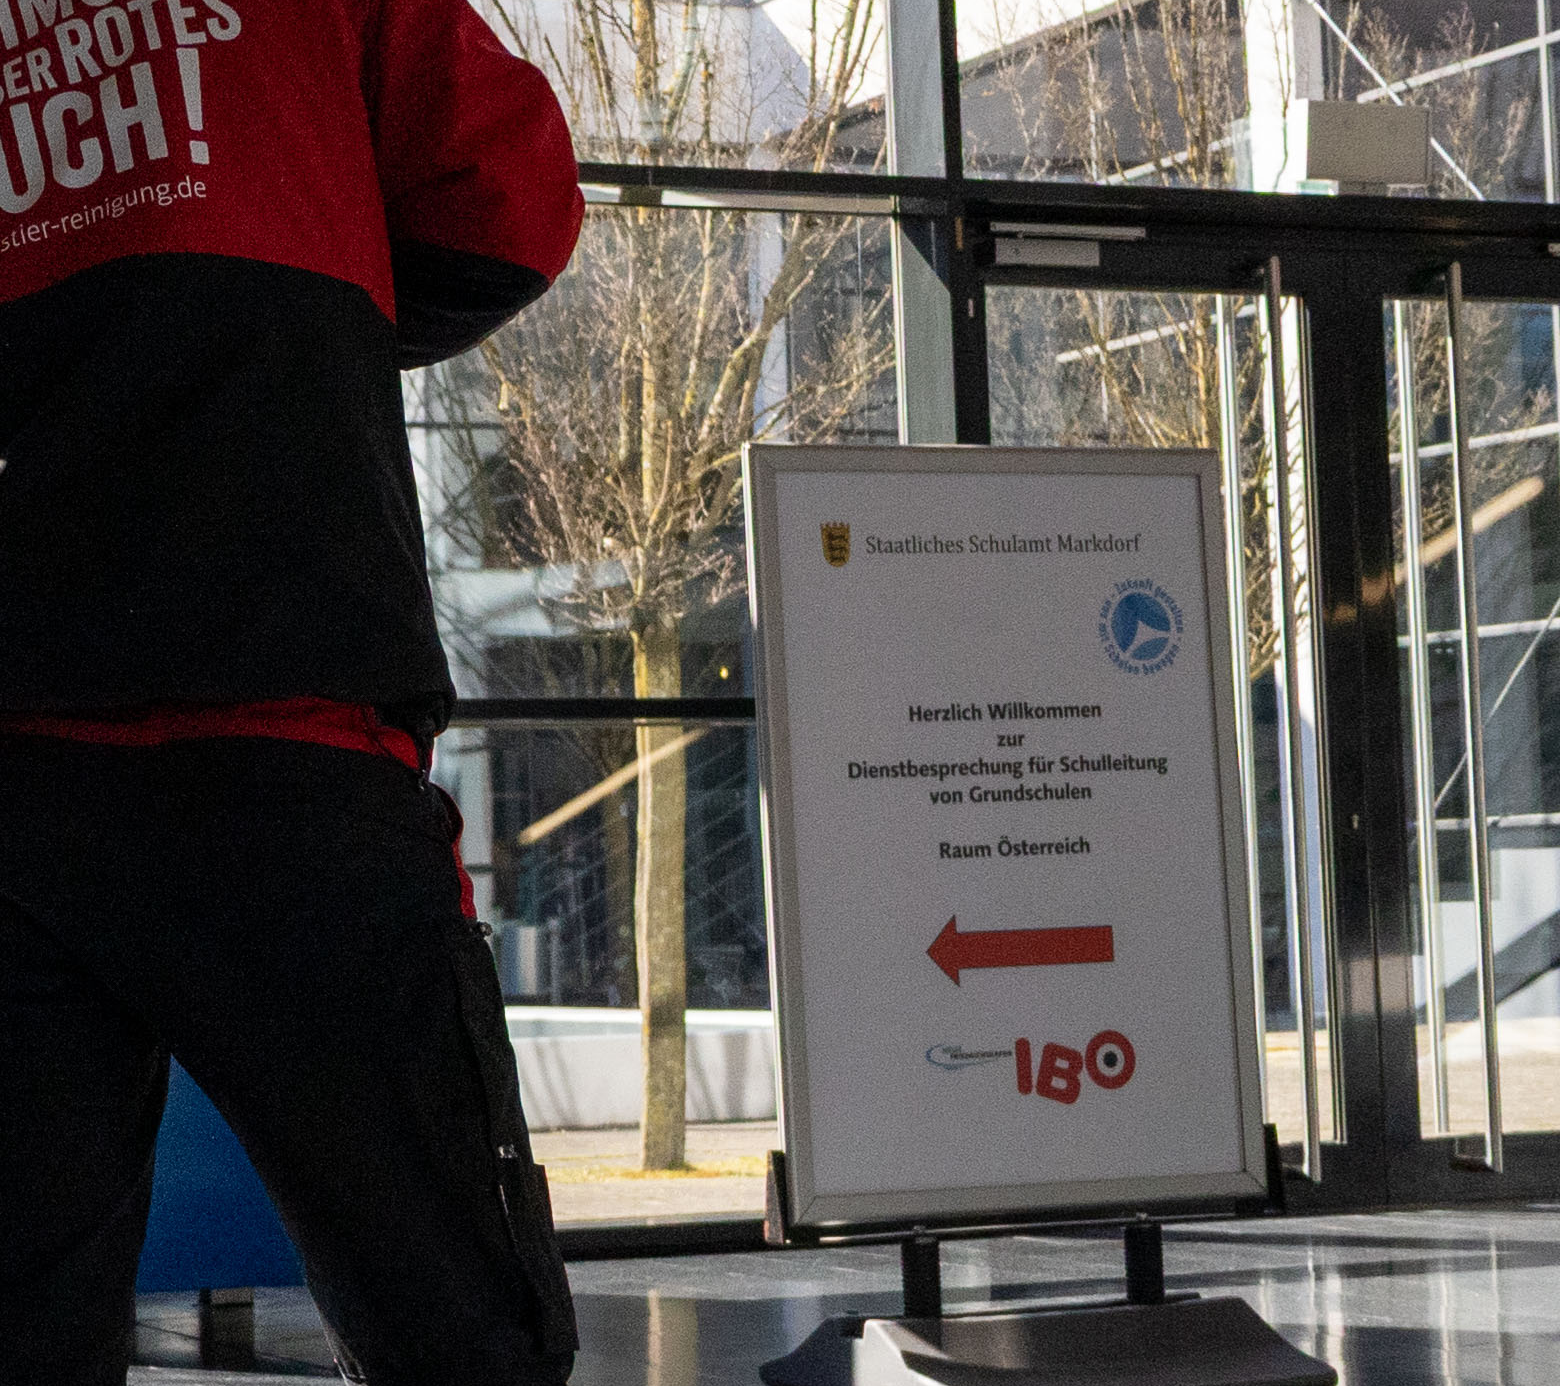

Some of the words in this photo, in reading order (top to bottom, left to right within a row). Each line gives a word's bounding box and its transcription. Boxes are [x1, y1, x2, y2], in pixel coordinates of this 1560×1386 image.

[864, 534, 964, 555] Staatliches
[968, 534, 1053, 555] Schulamt
[1057, 533, 1143, 555] Markdorf
[908, 703, 983, 724] Herzlich
[987, 701, 1102, 722] Willkommen
[996, 733, 1026, 748] zur
[847, 758, 1024, 782] Dienstbesprechung
[1028, 756, 1054, 775] für
[1059, 754, 1169, 776] Schulleitung
[929, 789, 963, 804] von
[969, 784, 1092, 804] Grundschulen
[938, 842, 992, 859] Raum
[997, 835, 1091, 858] Österreich
[1015, 1029, 1136, 1105] IBO
